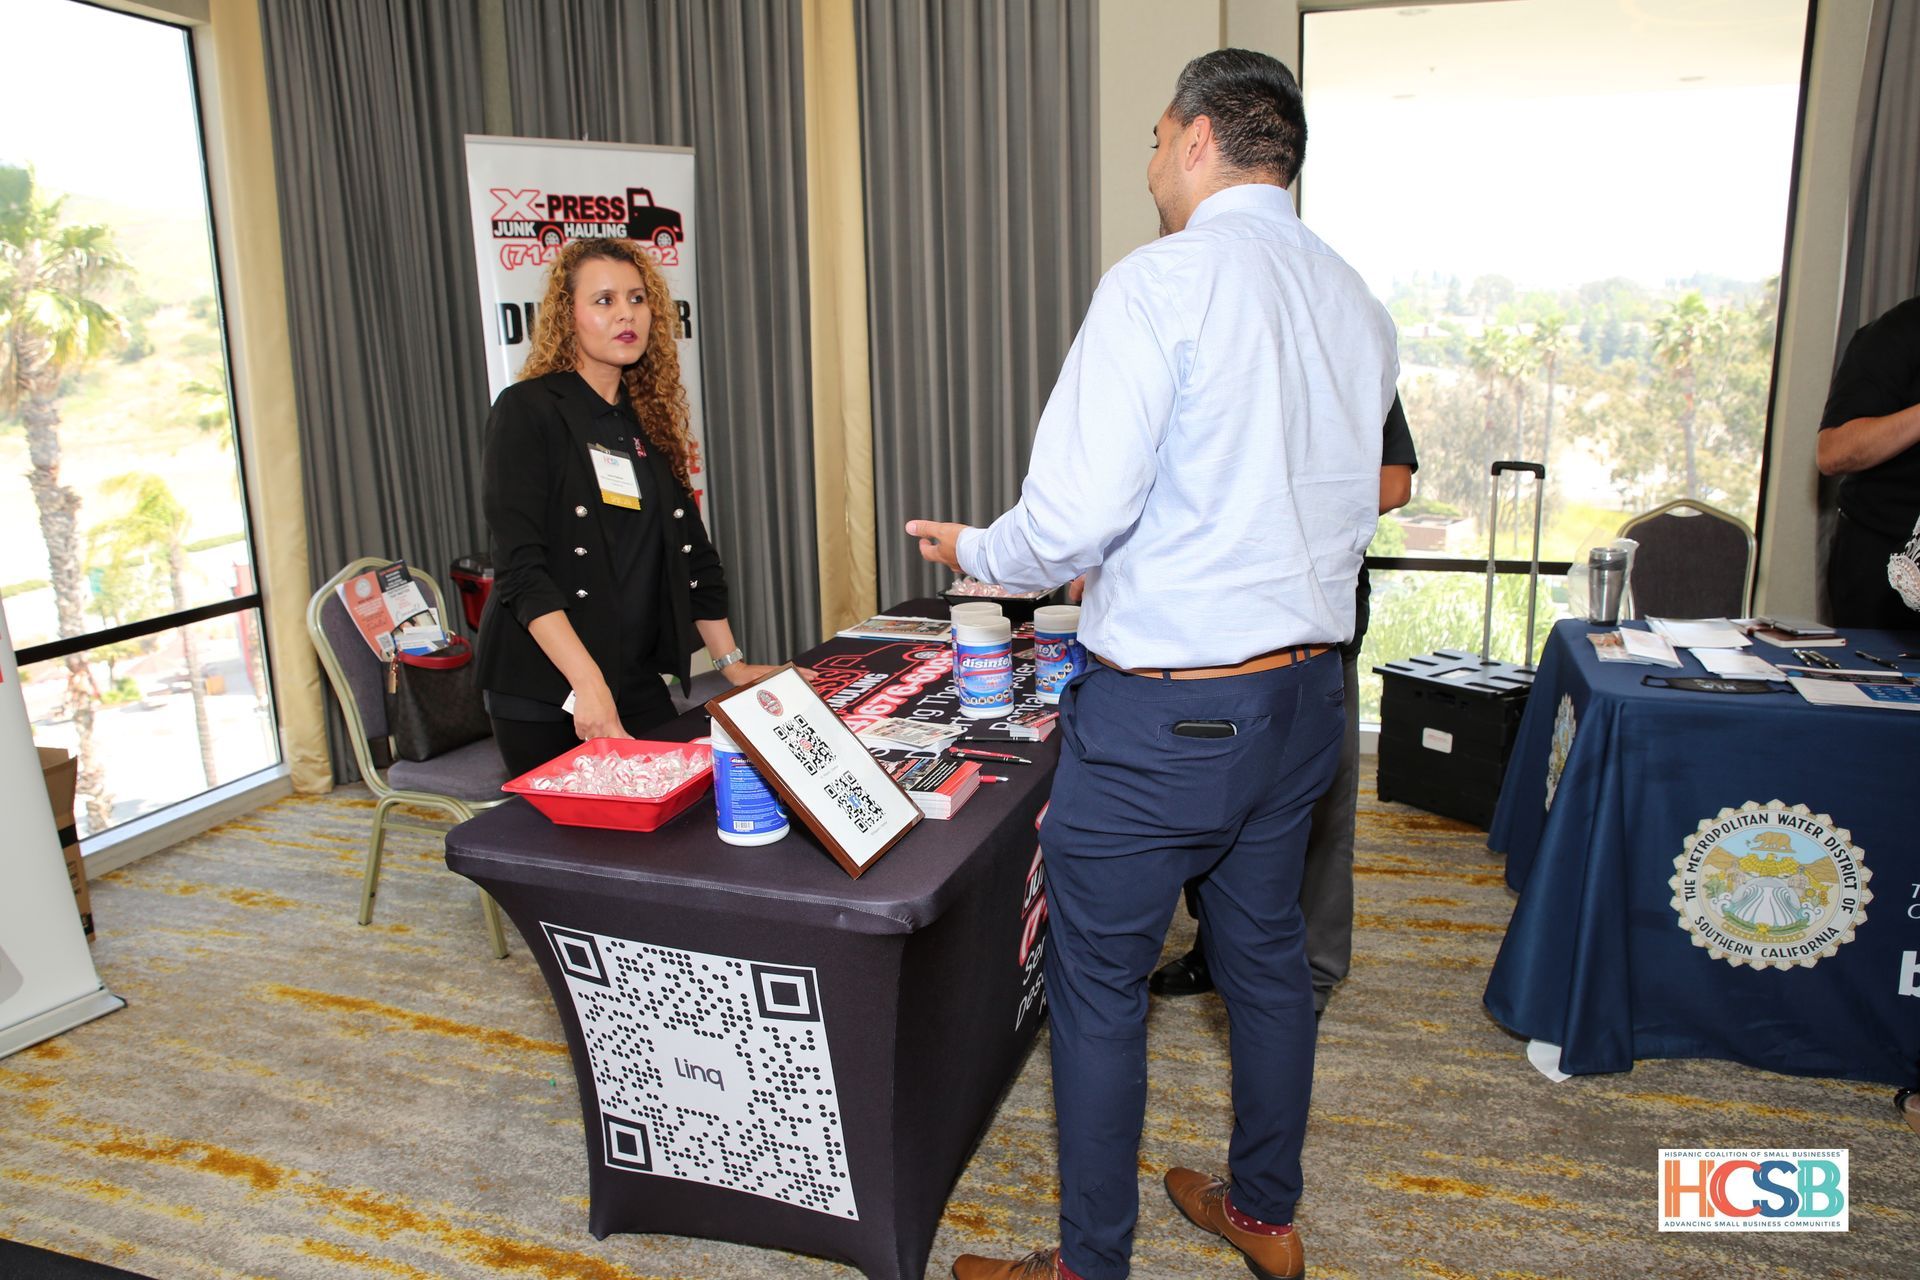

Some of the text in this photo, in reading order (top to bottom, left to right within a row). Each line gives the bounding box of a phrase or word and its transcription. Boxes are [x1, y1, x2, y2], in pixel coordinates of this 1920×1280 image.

[490, 188, 627, 221] X-PRESS
[493, 221, 628, 239] JUNK HAULING
[1684, 812, 1858, 915] THE METROPOLITAN WATER DISTRICT OF
[1693, 914, 1840, 958] SOUTHERN CALIFORNIA
